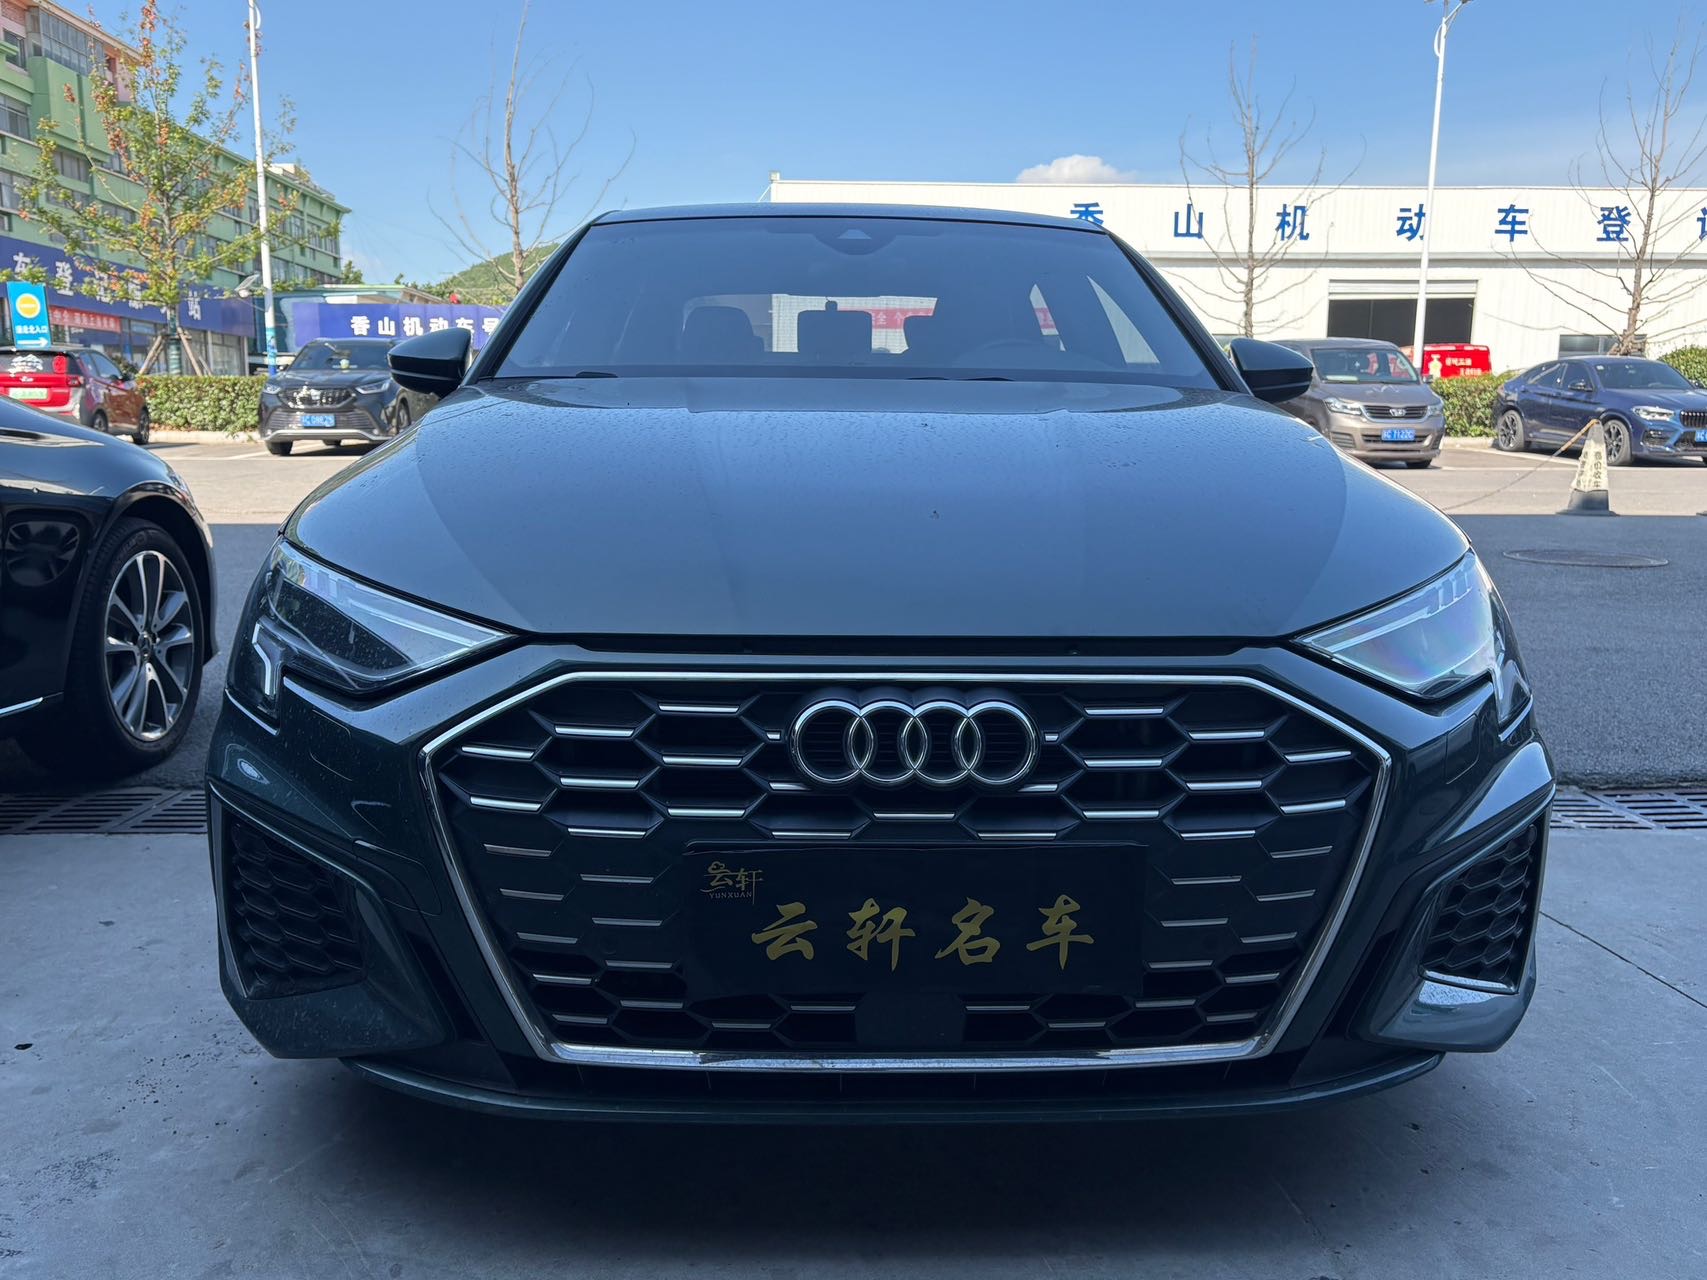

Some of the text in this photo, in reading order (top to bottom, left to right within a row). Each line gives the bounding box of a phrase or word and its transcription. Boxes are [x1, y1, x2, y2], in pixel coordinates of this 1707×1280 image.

[709, 891, 753, 899] YUNXUAN
[751, 894, 1095, 971] 云轩名车
